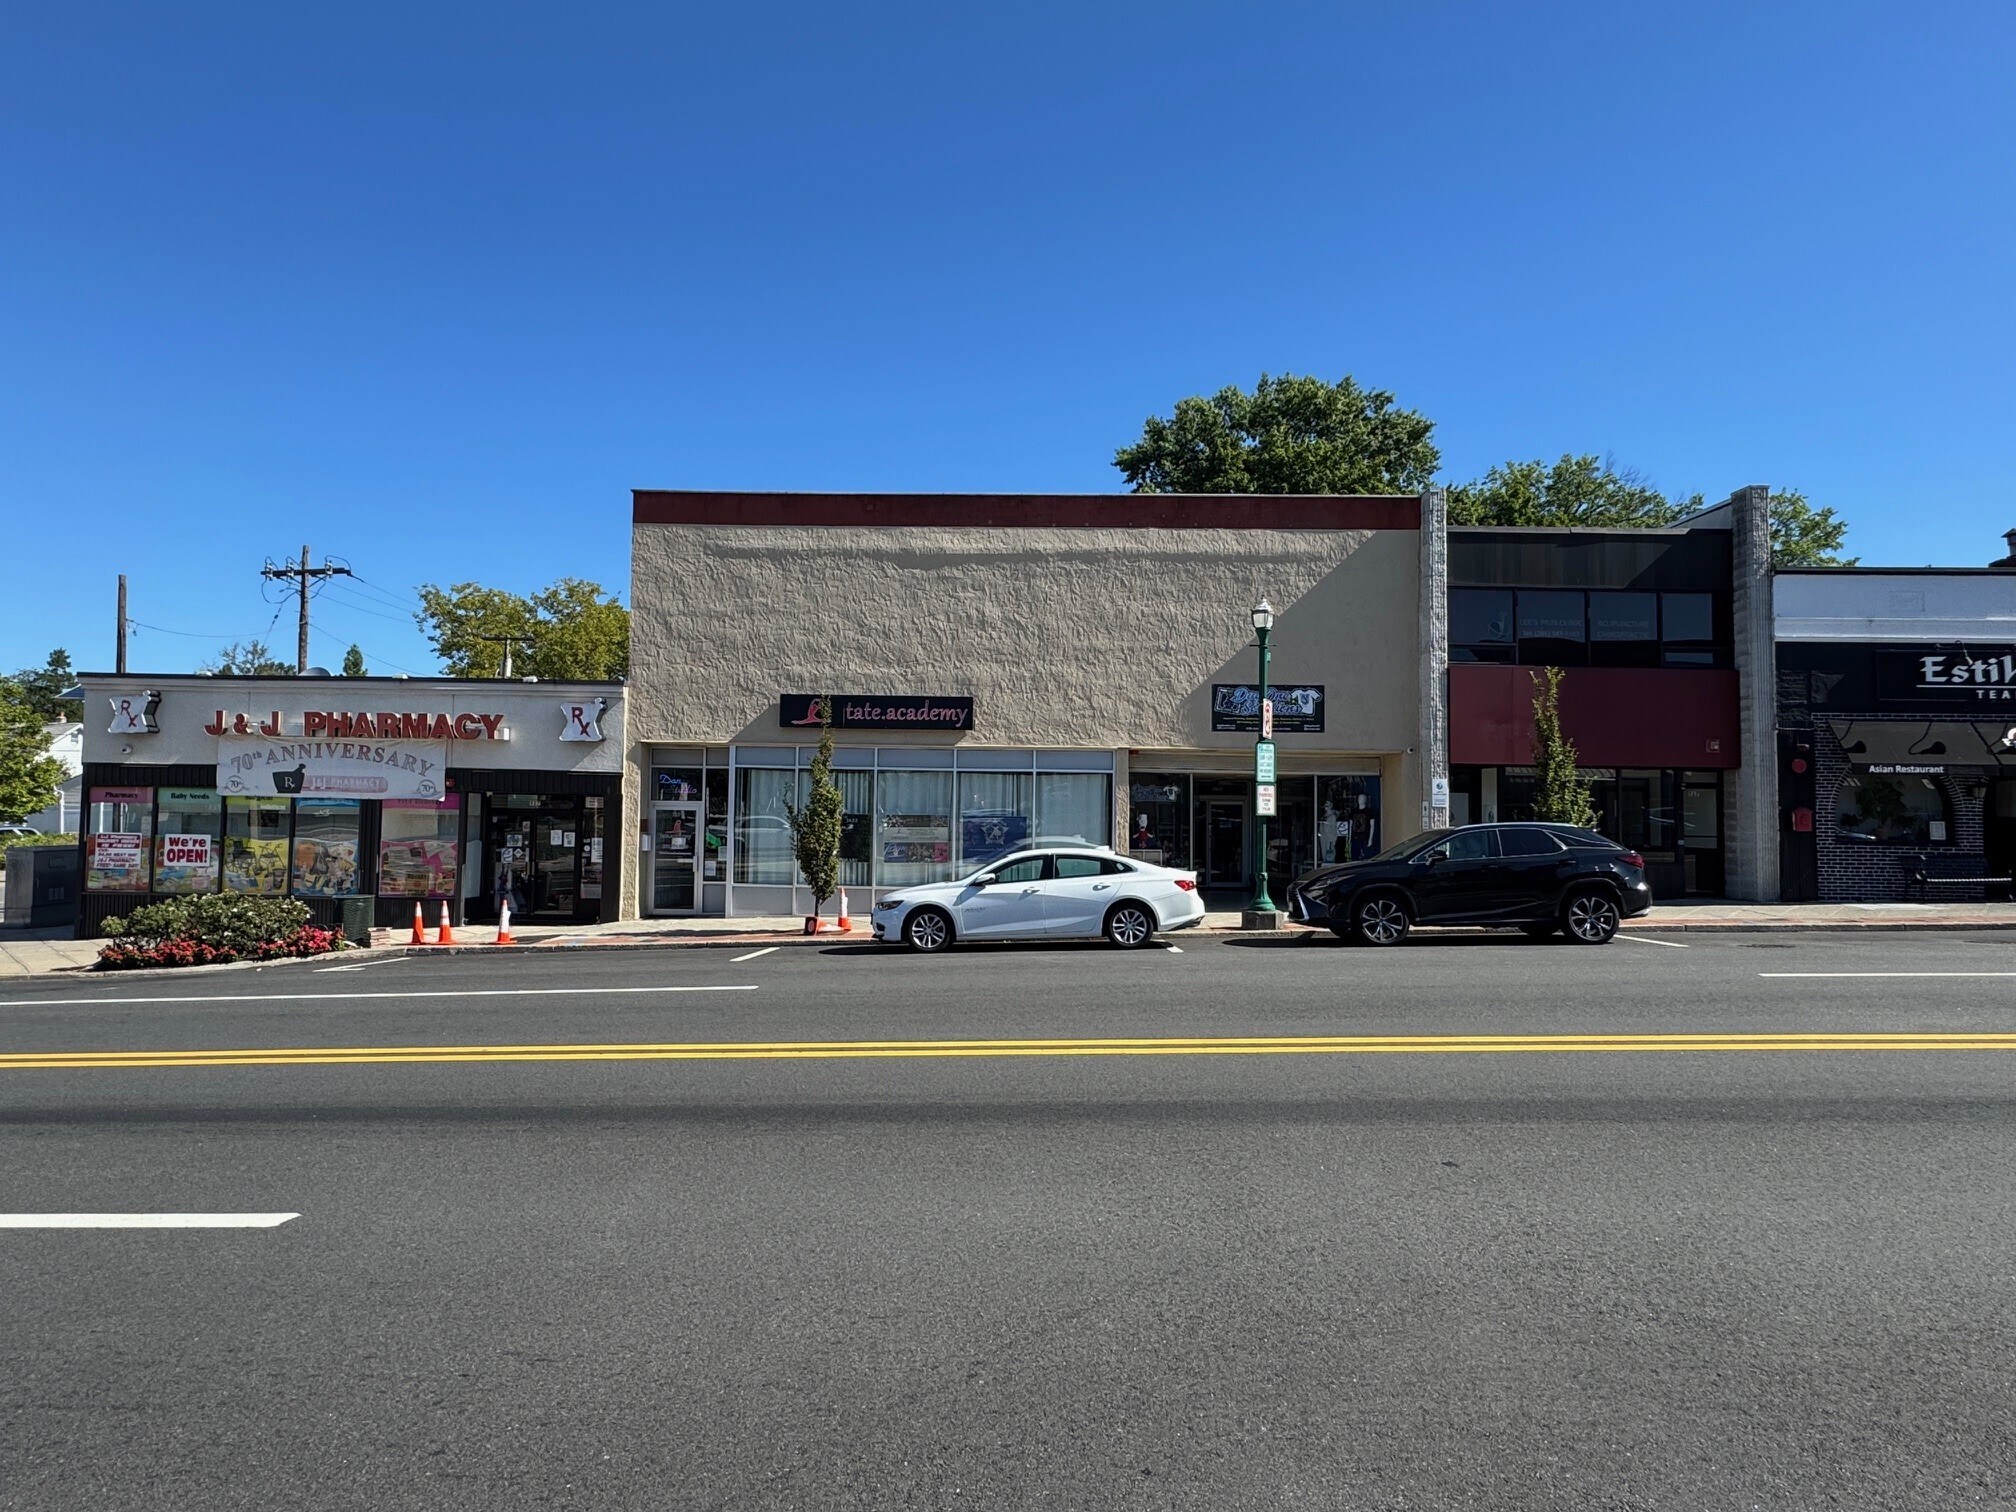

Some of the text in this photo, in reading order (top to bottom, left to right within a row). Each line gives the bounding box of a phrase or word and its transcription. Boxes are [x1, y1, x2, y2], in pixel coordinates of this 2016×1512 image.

[1976, 690, 2016, 699] TEA
[845, 699, 968, 727] tate.academy
[303, 711, 505, 740] PHARMACY
[230, 742, 435, 777] 70th ANNIVERSARY
[1868, 765, 1944, 773] Asian Restaurant
[331, 777, 380, 789] PHARMACY
[169, 837, 206, 847] We're
[167, 849, 208, 863] OPEN!
